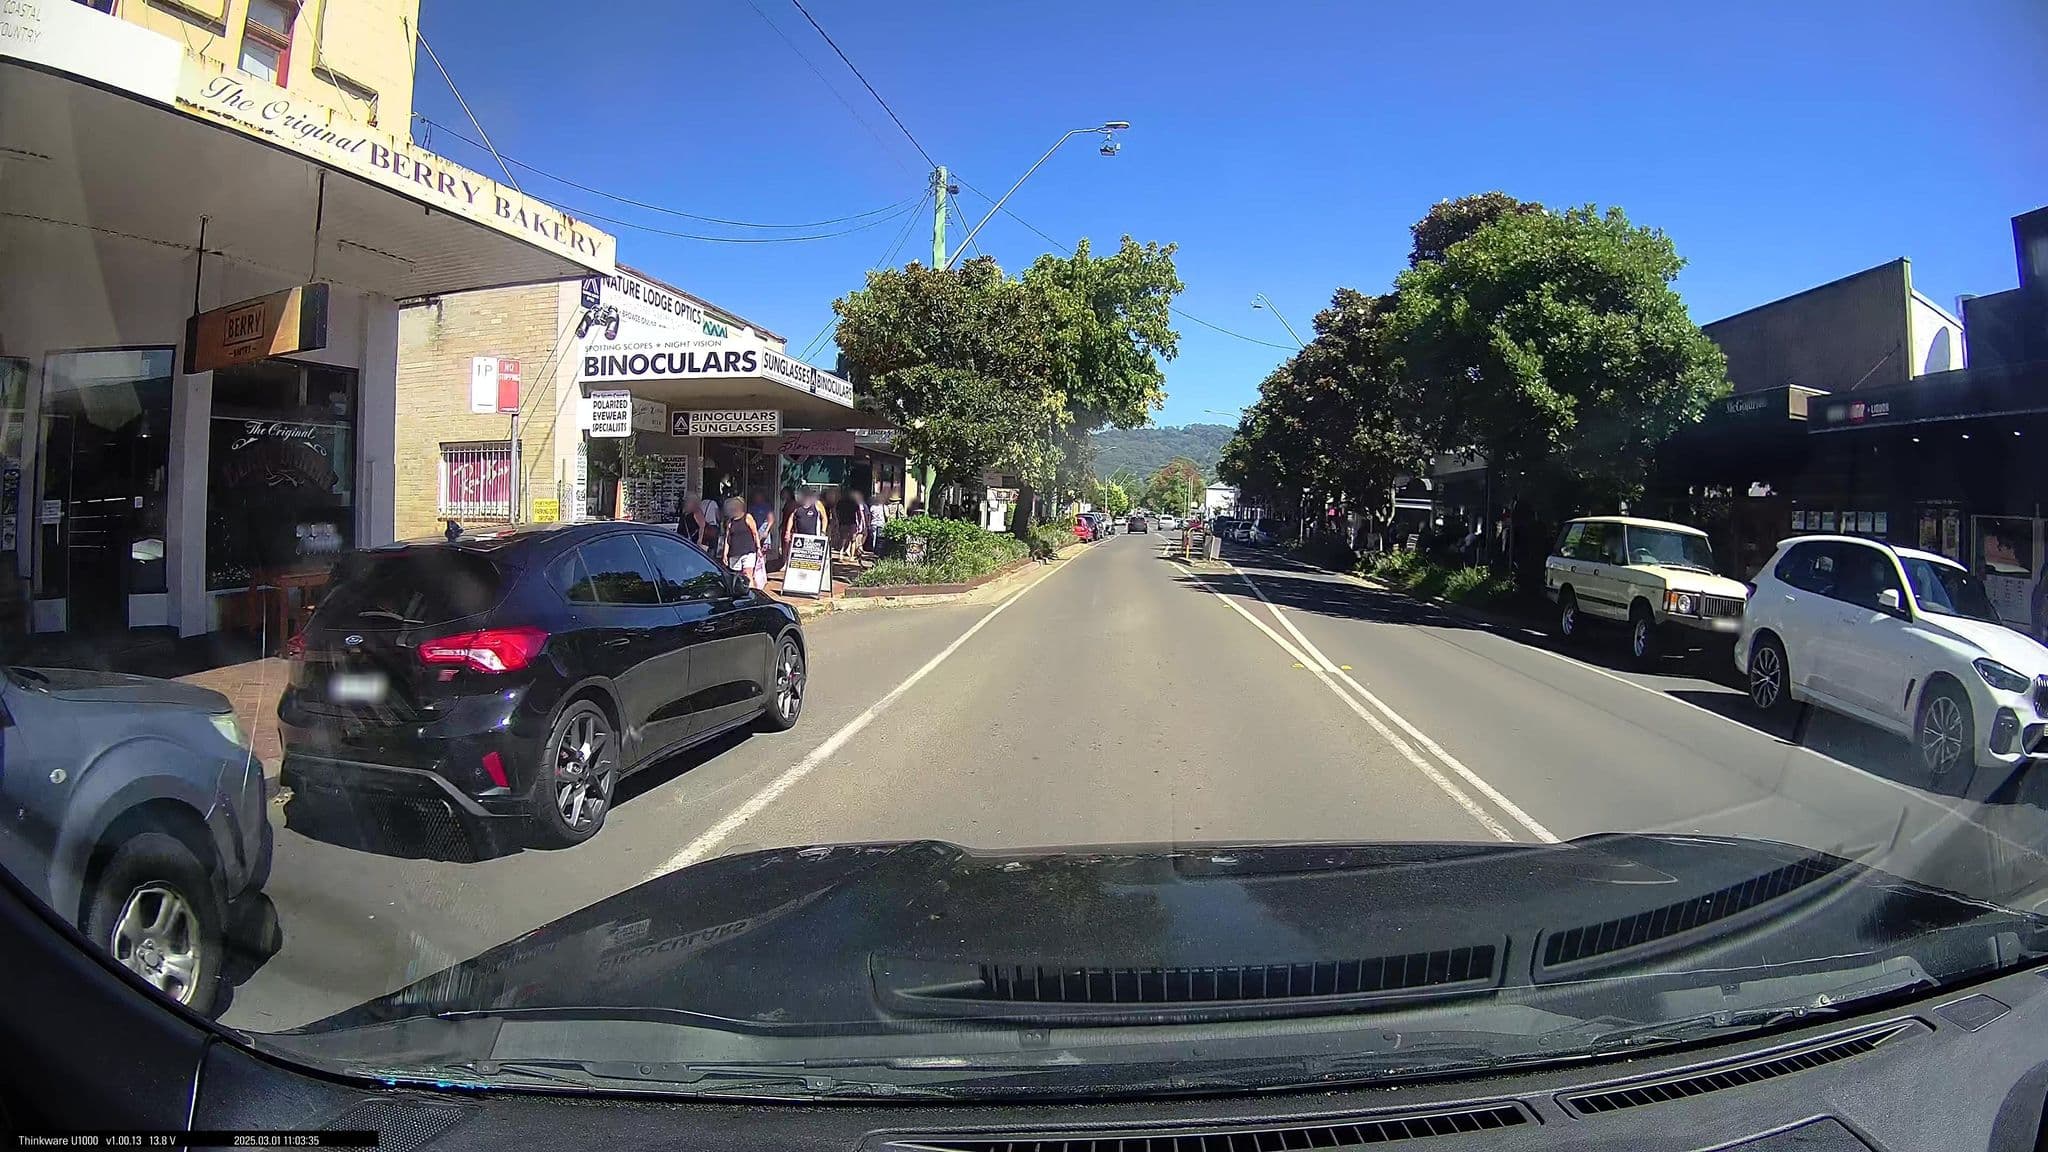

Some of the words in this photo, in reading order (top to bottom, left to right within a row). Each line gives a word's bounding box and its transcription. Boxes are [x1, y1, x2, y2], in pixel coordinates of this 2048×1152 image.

[200, 76, 254, 111] The
[261, 100, 366, 153] Original
[369, 141, 482, 204] BERRY
[494, 195, 602, 257] BAKERY
[602, 276, 640, 300] NATURE
[643, 286, 672, 313] LODGE
[674, 300, 701, 325] OPTICS
[228, 309, 262, 338] BERRY
[585, 344, 622, 353] SPOTTING
[623, 342, 653, 351] SCOPES
[664, 340, 692, 349] NIGHT
[693, 339, 722, 348] VISION
[584, 350, 757, 377] BINOCULARS
[763, 352, 811, 385] SUNGLASSES
[816, 373, 853, 401] BINOCULARS
[592, 400, 628, 409] POLARIZED
[592, 411, 627, 421] EYEWEAR
[691, 411, 776, 422] BINOCULARS
[245, 420, 266, 436] The
[268, 422, 316, 441] Original
[592, 422, 627, 433] SPECIALISTS
[691, 423, 776, 433] SUNGLASSES
